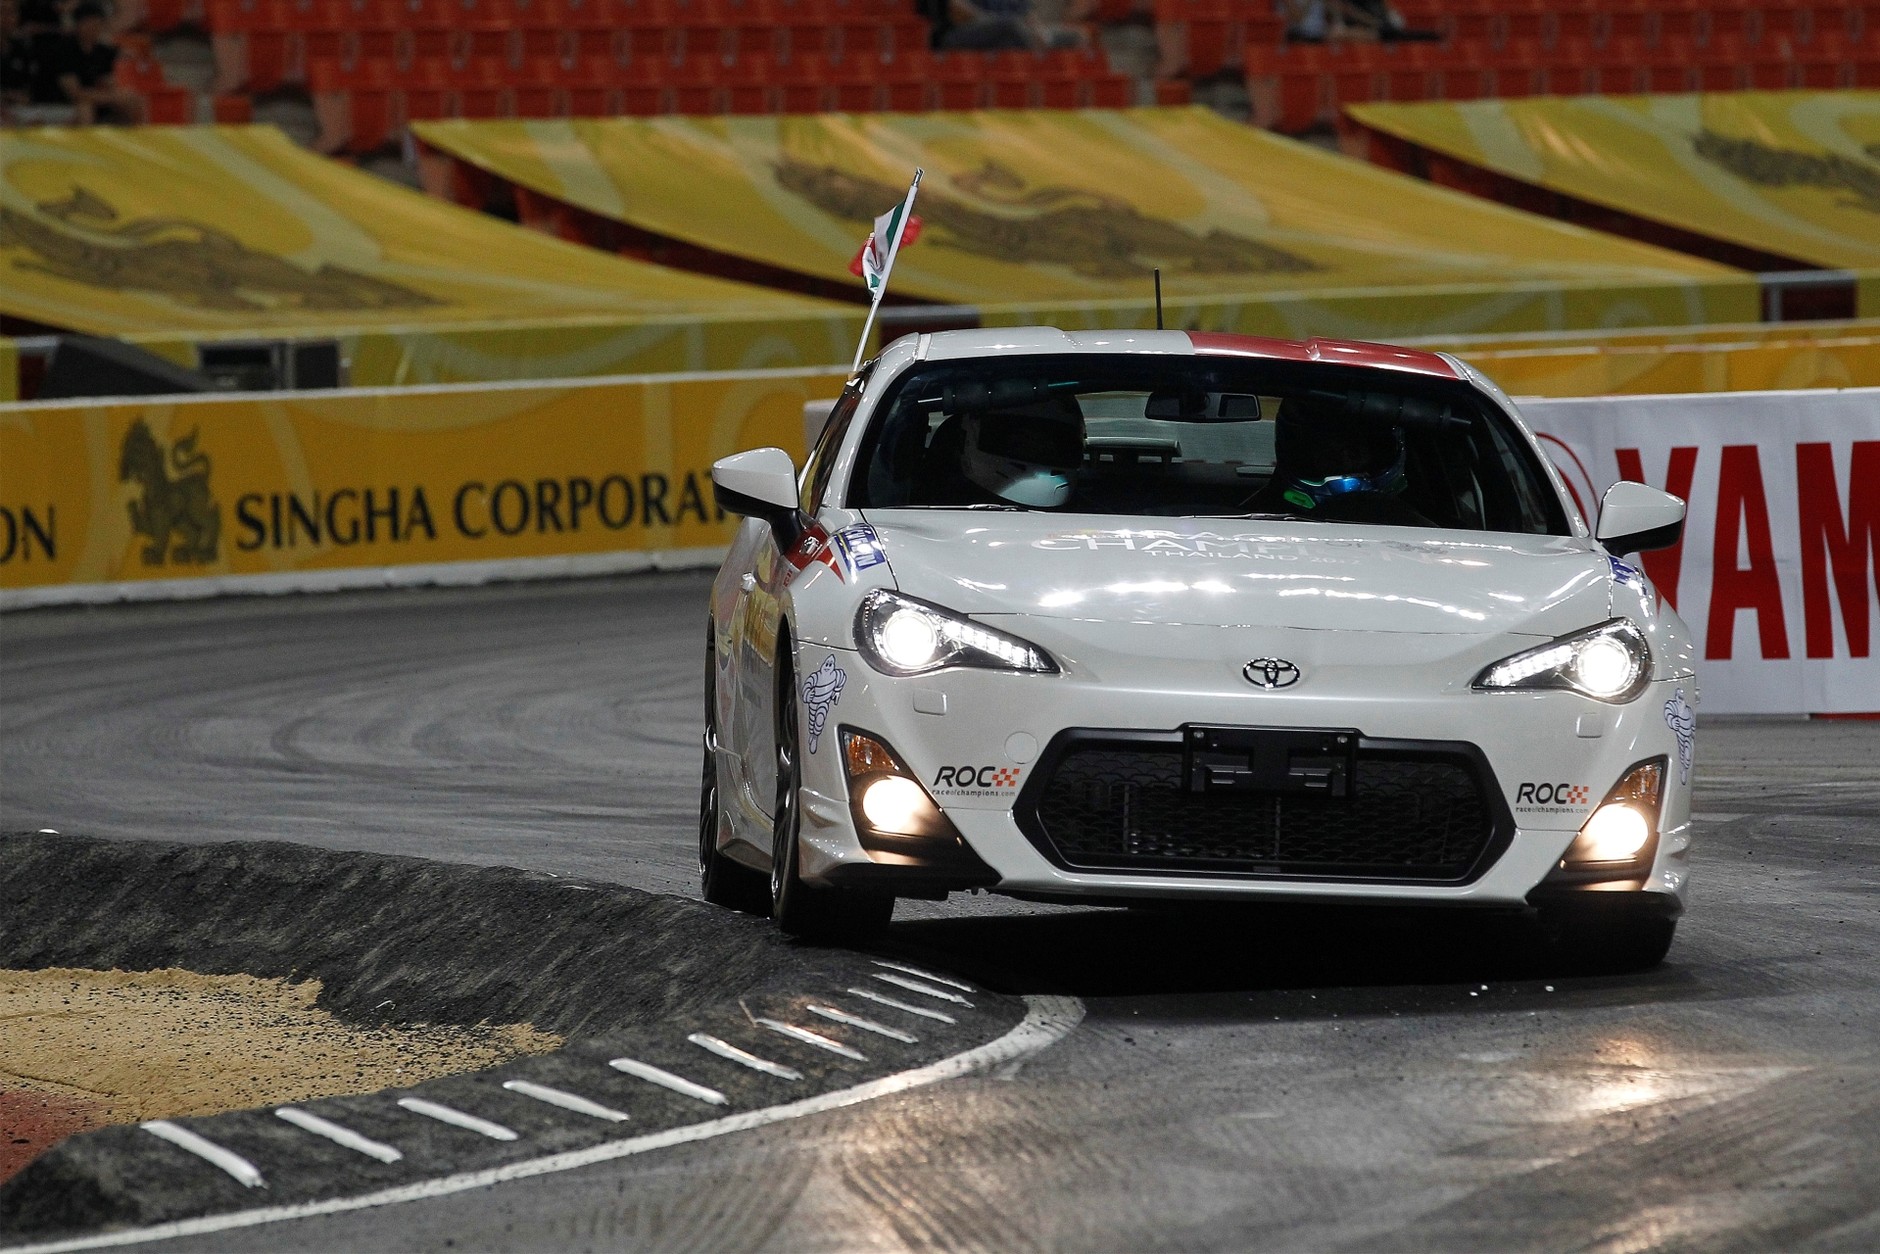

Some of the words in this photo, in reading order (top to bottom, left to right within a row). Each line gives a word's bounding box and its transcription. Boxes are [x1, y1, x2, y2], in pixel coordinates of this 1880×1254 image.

[235, 485, 437, 552] SINGHA
[1144, 550, 1299, 562] THAILAND
[933, 766, 996, 788] ROC
[1516, 782, 1570, 804] ROC
